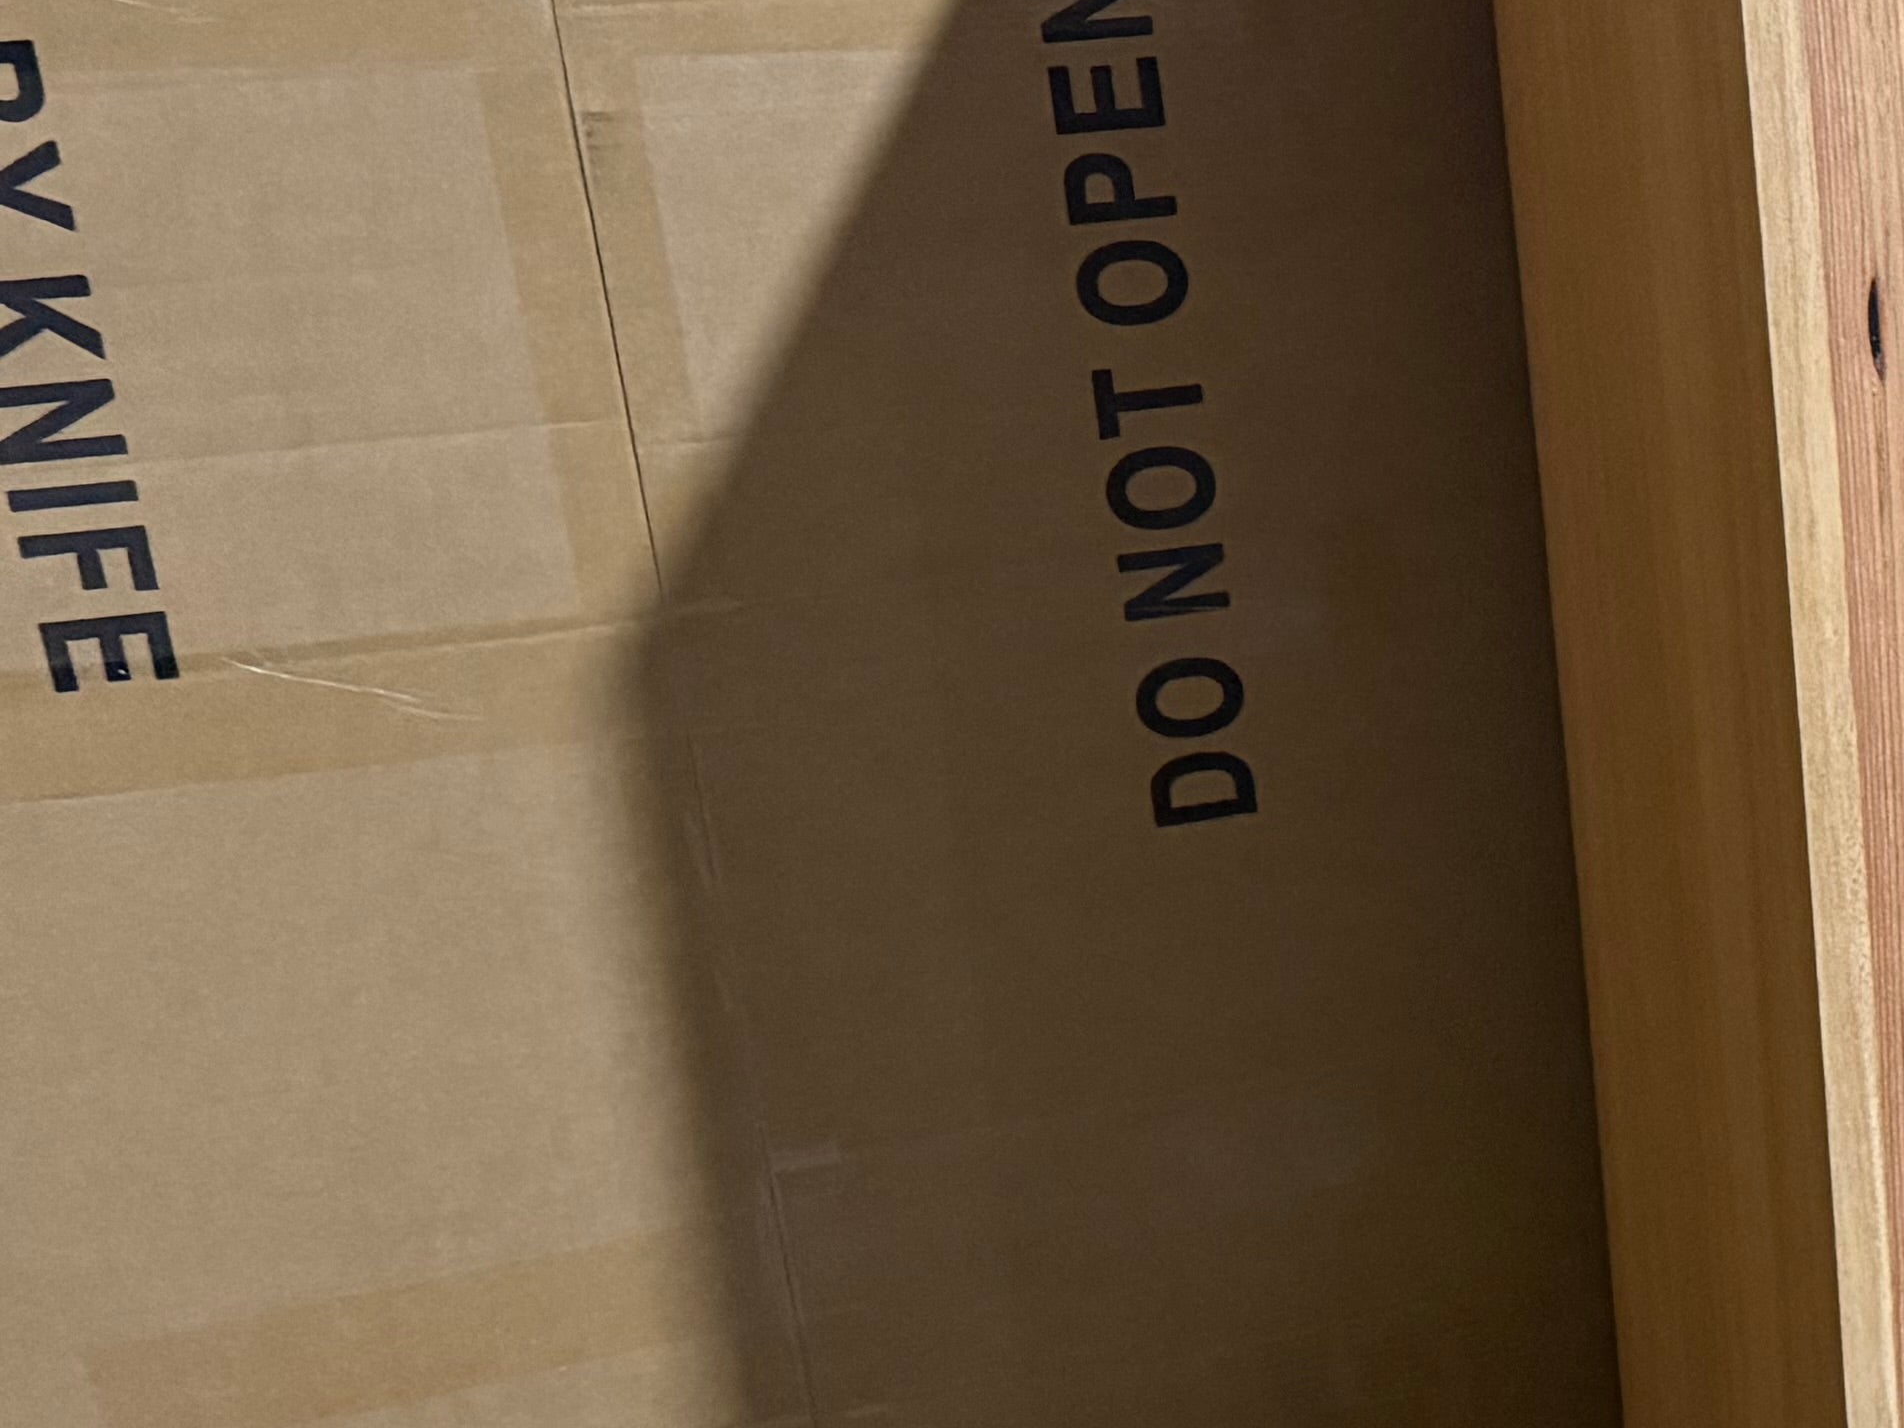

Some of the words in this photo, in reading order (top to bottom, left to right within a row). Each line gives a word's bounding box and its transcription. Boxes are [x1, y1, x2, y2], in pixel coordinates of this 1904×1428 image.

[0, 272, 182, 694] KNIFE
[1090, 368, 1232, 624] NOT
[1135, 656, 1259, 829] DO
